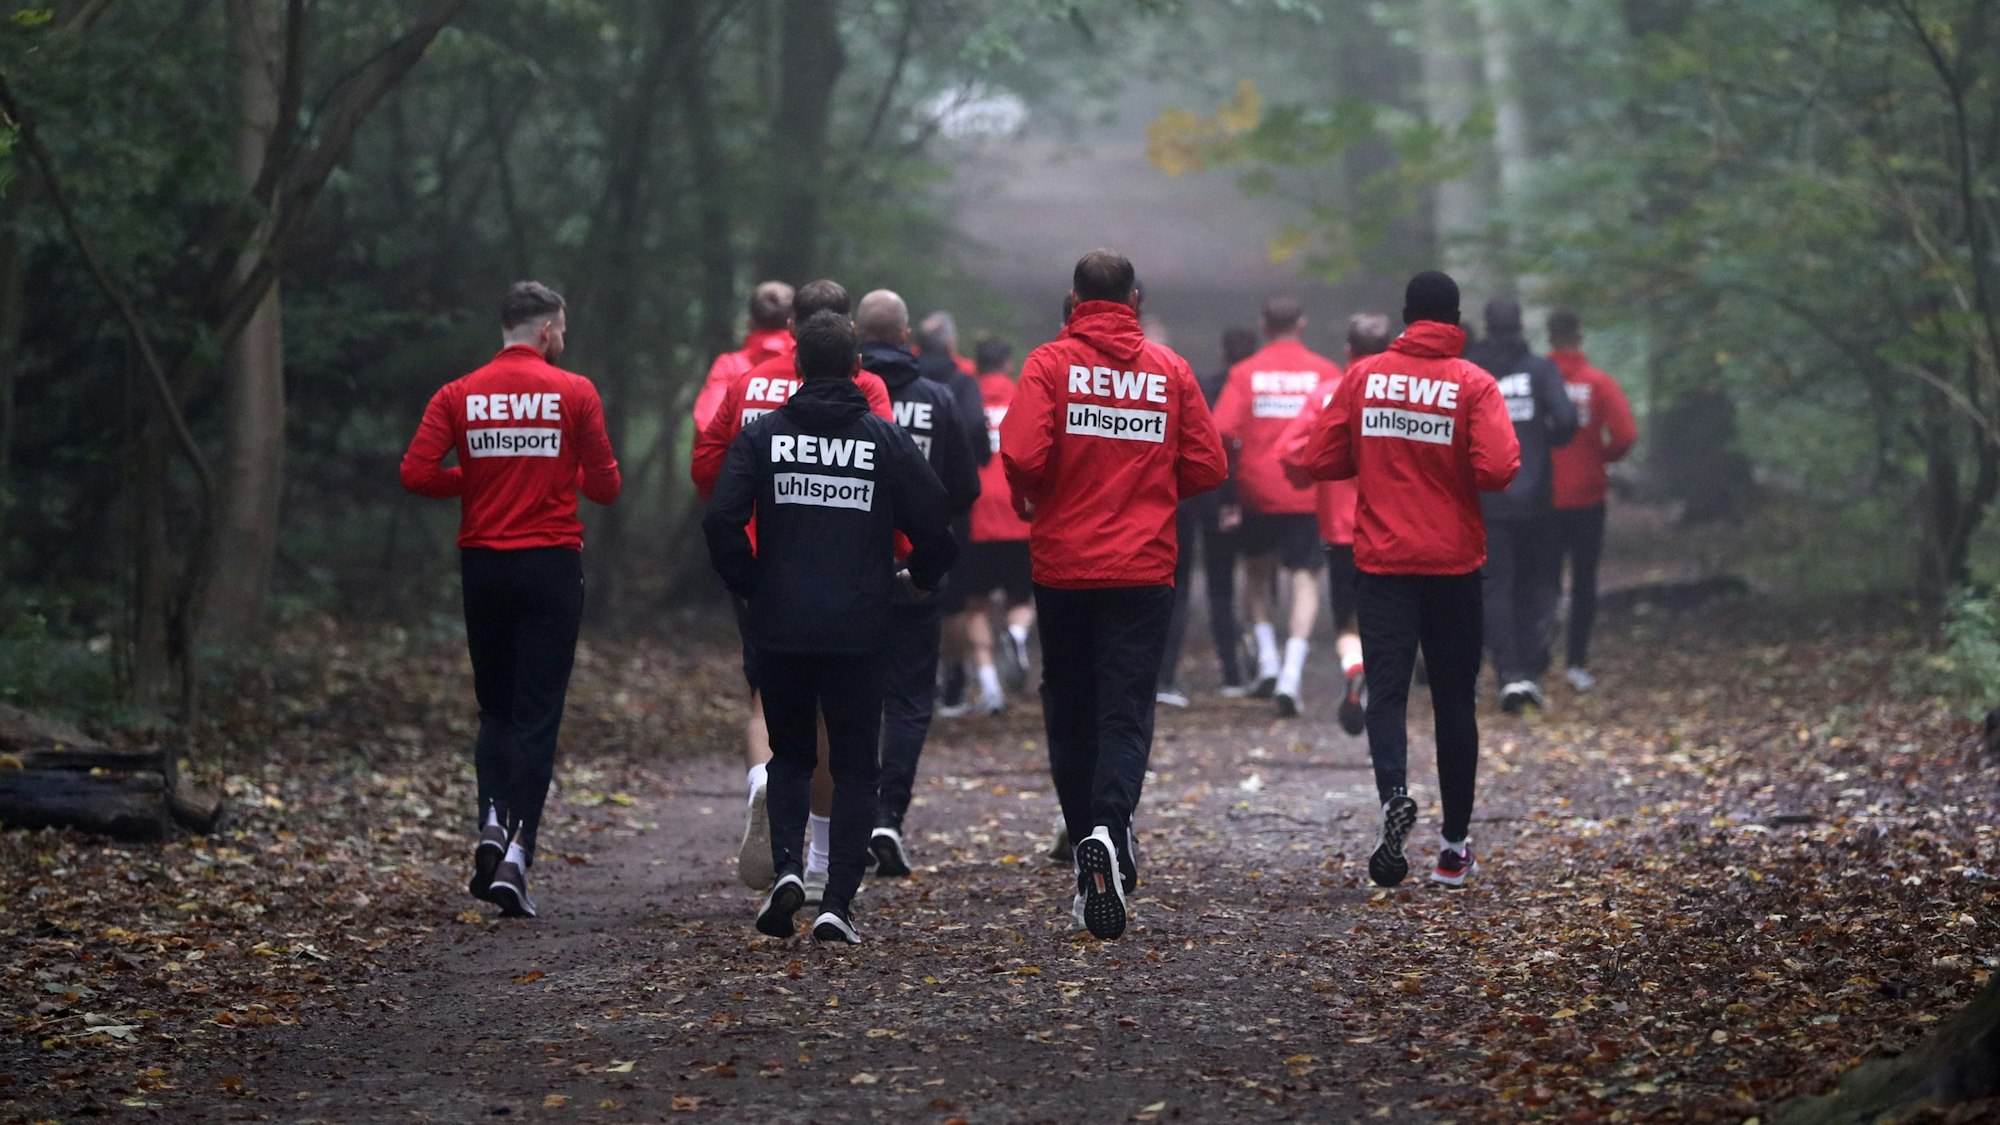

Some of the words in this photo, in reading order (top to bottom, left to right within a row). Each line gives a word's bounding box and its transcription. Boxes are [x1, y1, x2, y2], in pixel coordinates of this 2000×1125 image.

[745, 377, 803, 402] RE
[1068, 364, 1168, 403] REWE
[1364, 373, 1459, 409] REWE
[466, 393, 561, 421] REWE
[1069, 408, 1163, 435] uhlsport
[1365, 411, 1451, 438] uhlsport
[470, 431, 558, 453] uhlsport
[771, 434, 876, 471] REWE
[777, 476, 870, 503] uhlsport
